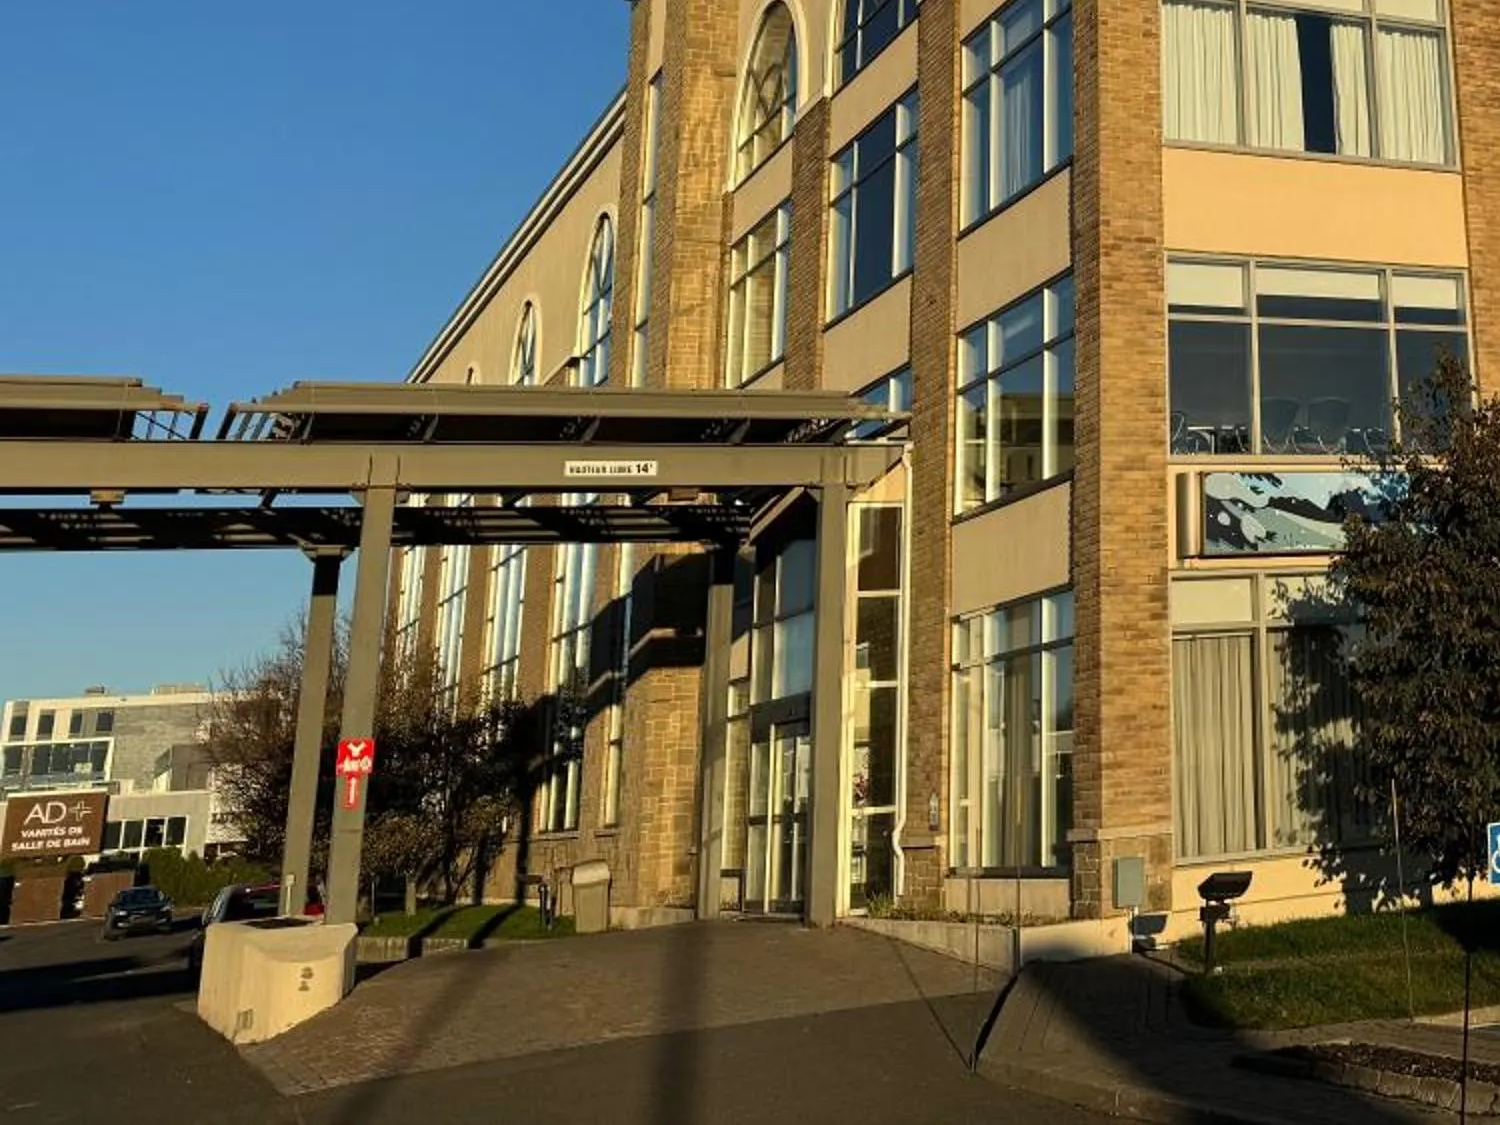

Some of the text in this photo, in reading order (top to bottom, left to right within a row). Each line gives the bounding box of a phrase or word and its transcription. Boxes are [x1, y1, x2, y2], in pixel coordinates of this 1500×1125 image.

[11, 836, 91, 852] SALLE DE BAIN
